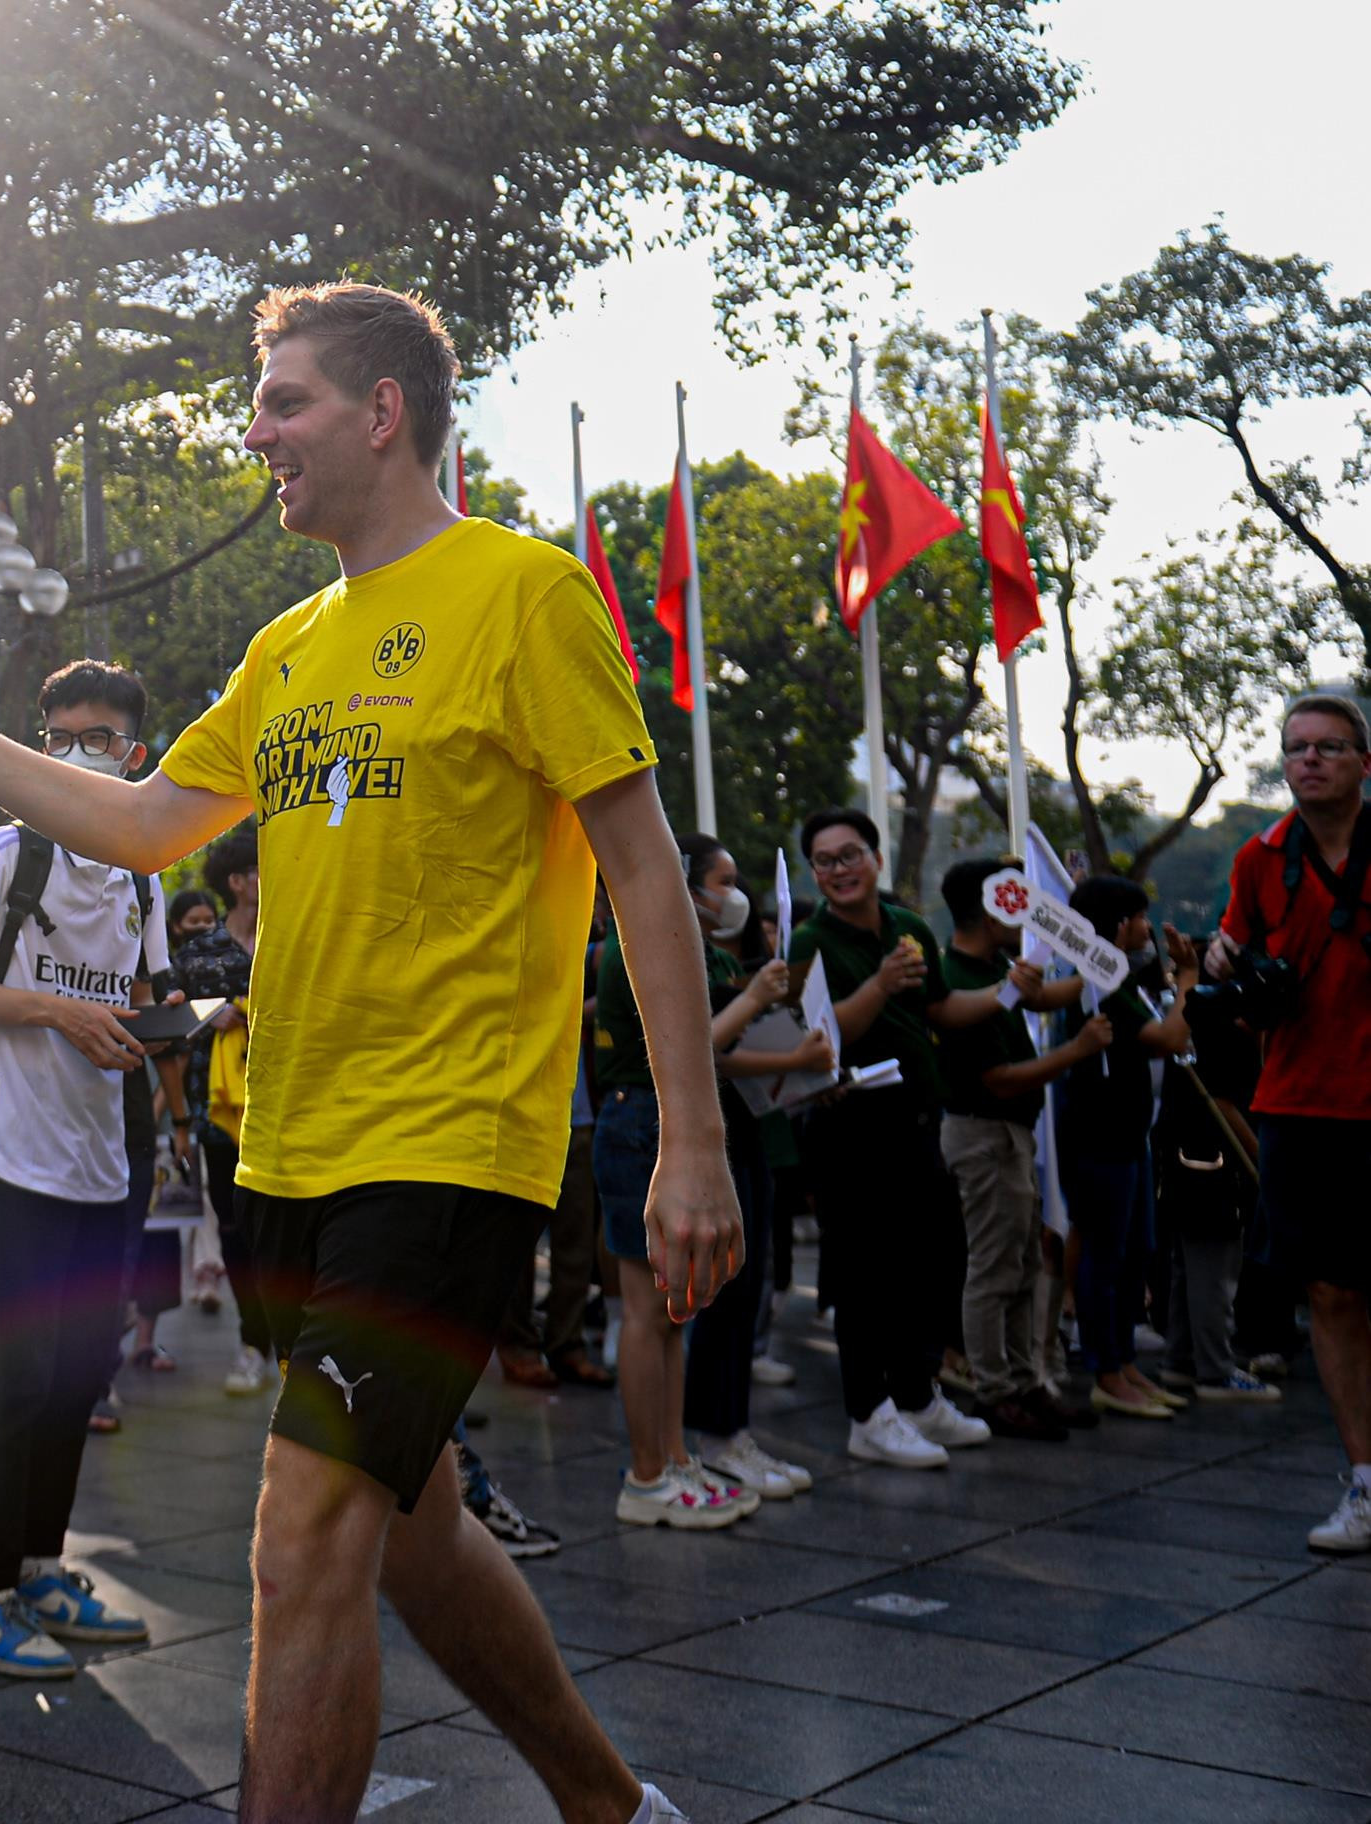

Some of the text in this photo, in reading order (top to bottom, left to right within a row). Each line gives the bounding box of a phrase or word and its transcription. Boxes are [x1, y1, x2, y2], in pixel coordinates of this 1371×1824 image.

[378, 627, 419, 662] BVB
[385, 661, 400, 673] 09
[364, 696, 414, 708] EVONIK
[309, 759, 403, 802] LVE!
